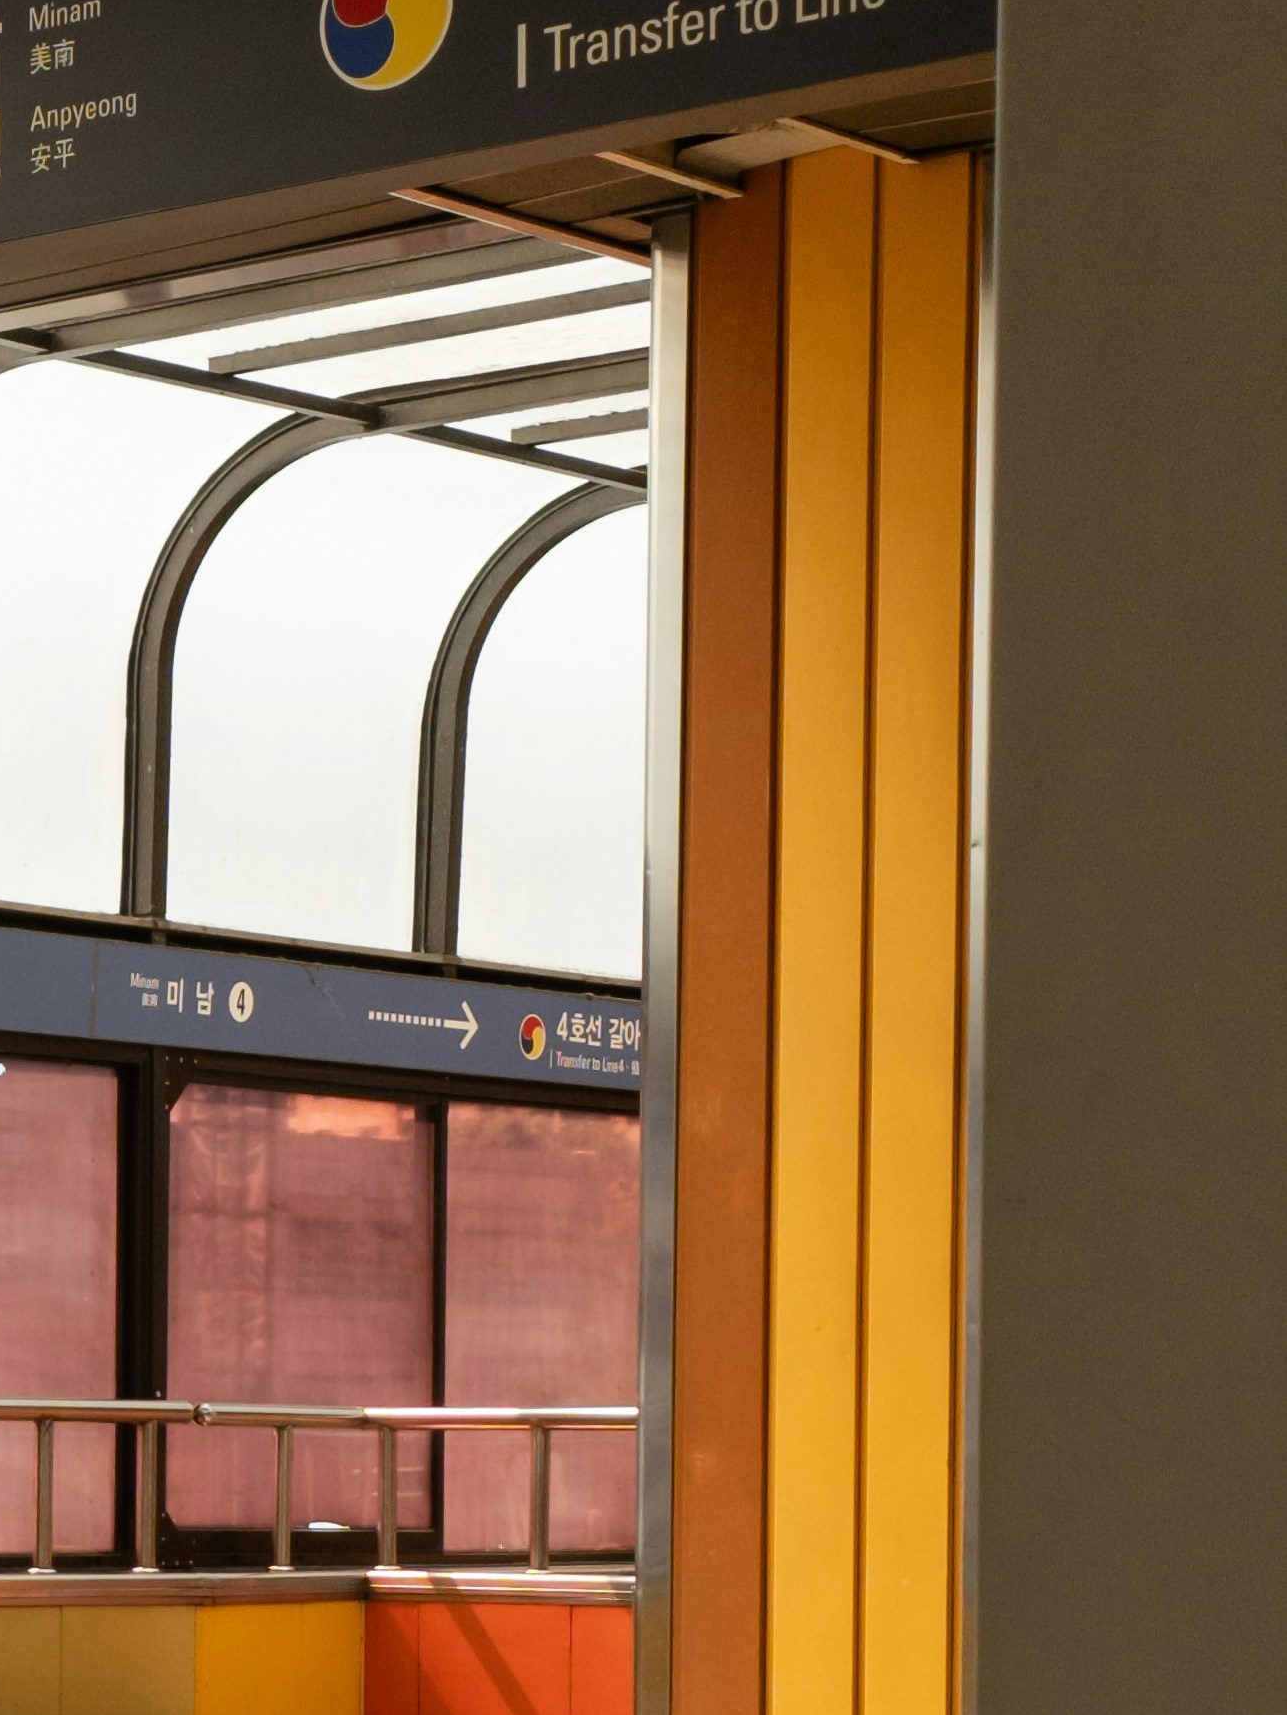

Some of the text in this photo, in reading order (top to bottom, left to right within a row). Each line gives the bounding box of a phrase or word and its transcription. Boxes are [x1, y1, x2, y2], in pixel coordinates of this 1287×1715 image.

[29, 0, 102, 32] Minam
[543, 0, 725, 72] Transfer
[29, 39, 76, 75] 美南
[29, 92, 138, 133] Anpyeong
[29, 137, 76, 175] 安平
[236, 988, 246, 1016] 4
[556, 1011, 602, 1047] 4호선
[556, 1050, 591, 1069] Transfer
